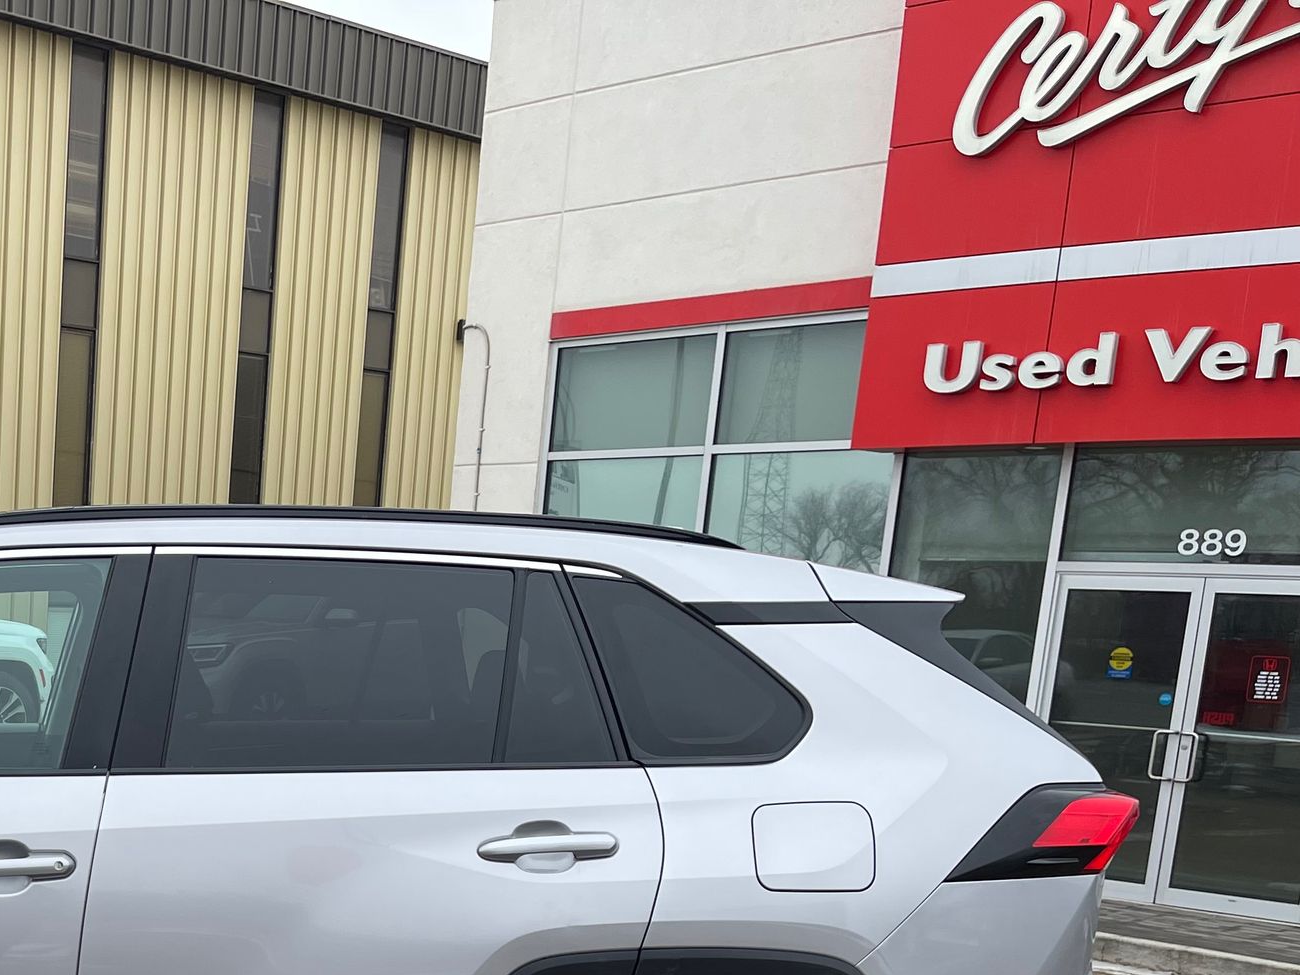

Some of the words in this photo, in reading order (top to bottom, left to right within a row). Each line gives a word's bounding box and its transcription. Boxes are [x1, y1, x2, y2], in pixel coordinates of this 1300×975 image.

[923, 331, 1120, 393] Used
[1144, 322, 1300, 383] Veh
[1177, 528, 1247, 557] 889
